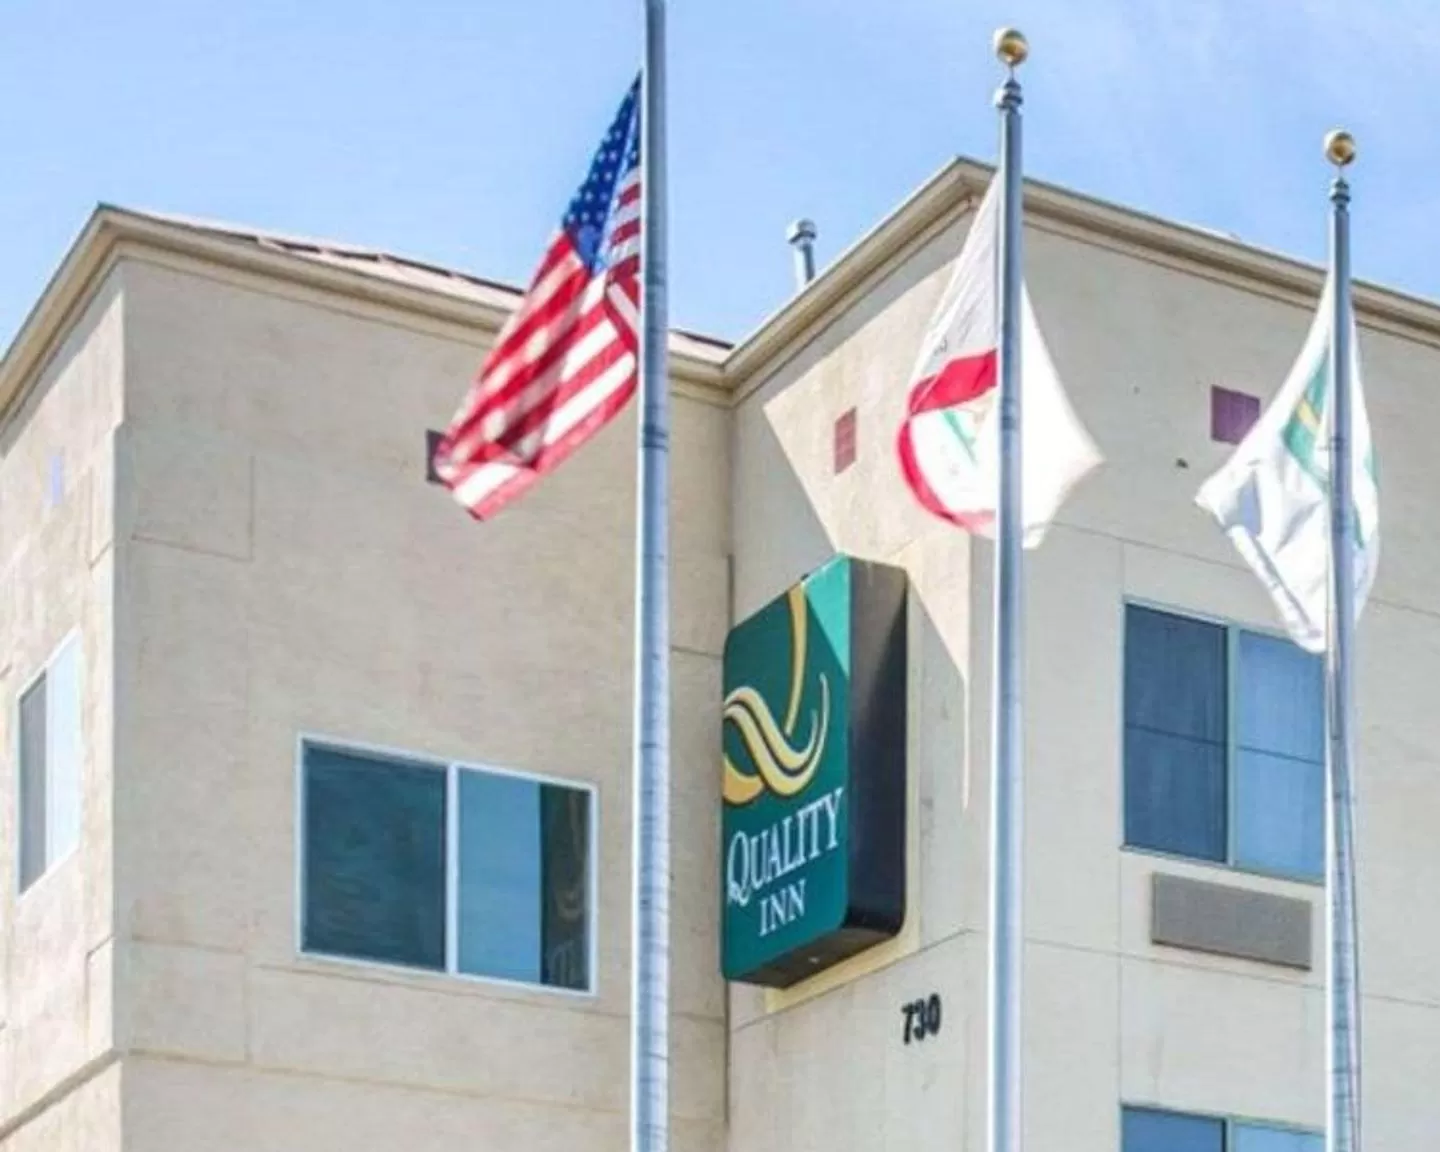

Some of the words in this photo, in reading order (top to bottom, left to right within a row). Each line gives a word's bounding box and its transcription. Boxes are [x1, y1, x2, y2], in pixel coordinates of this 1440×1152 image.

[726, 786, 843, 905] QUALITY
[759, 879, 806, 937] INN
[902, 993, 941, 1045] 730
